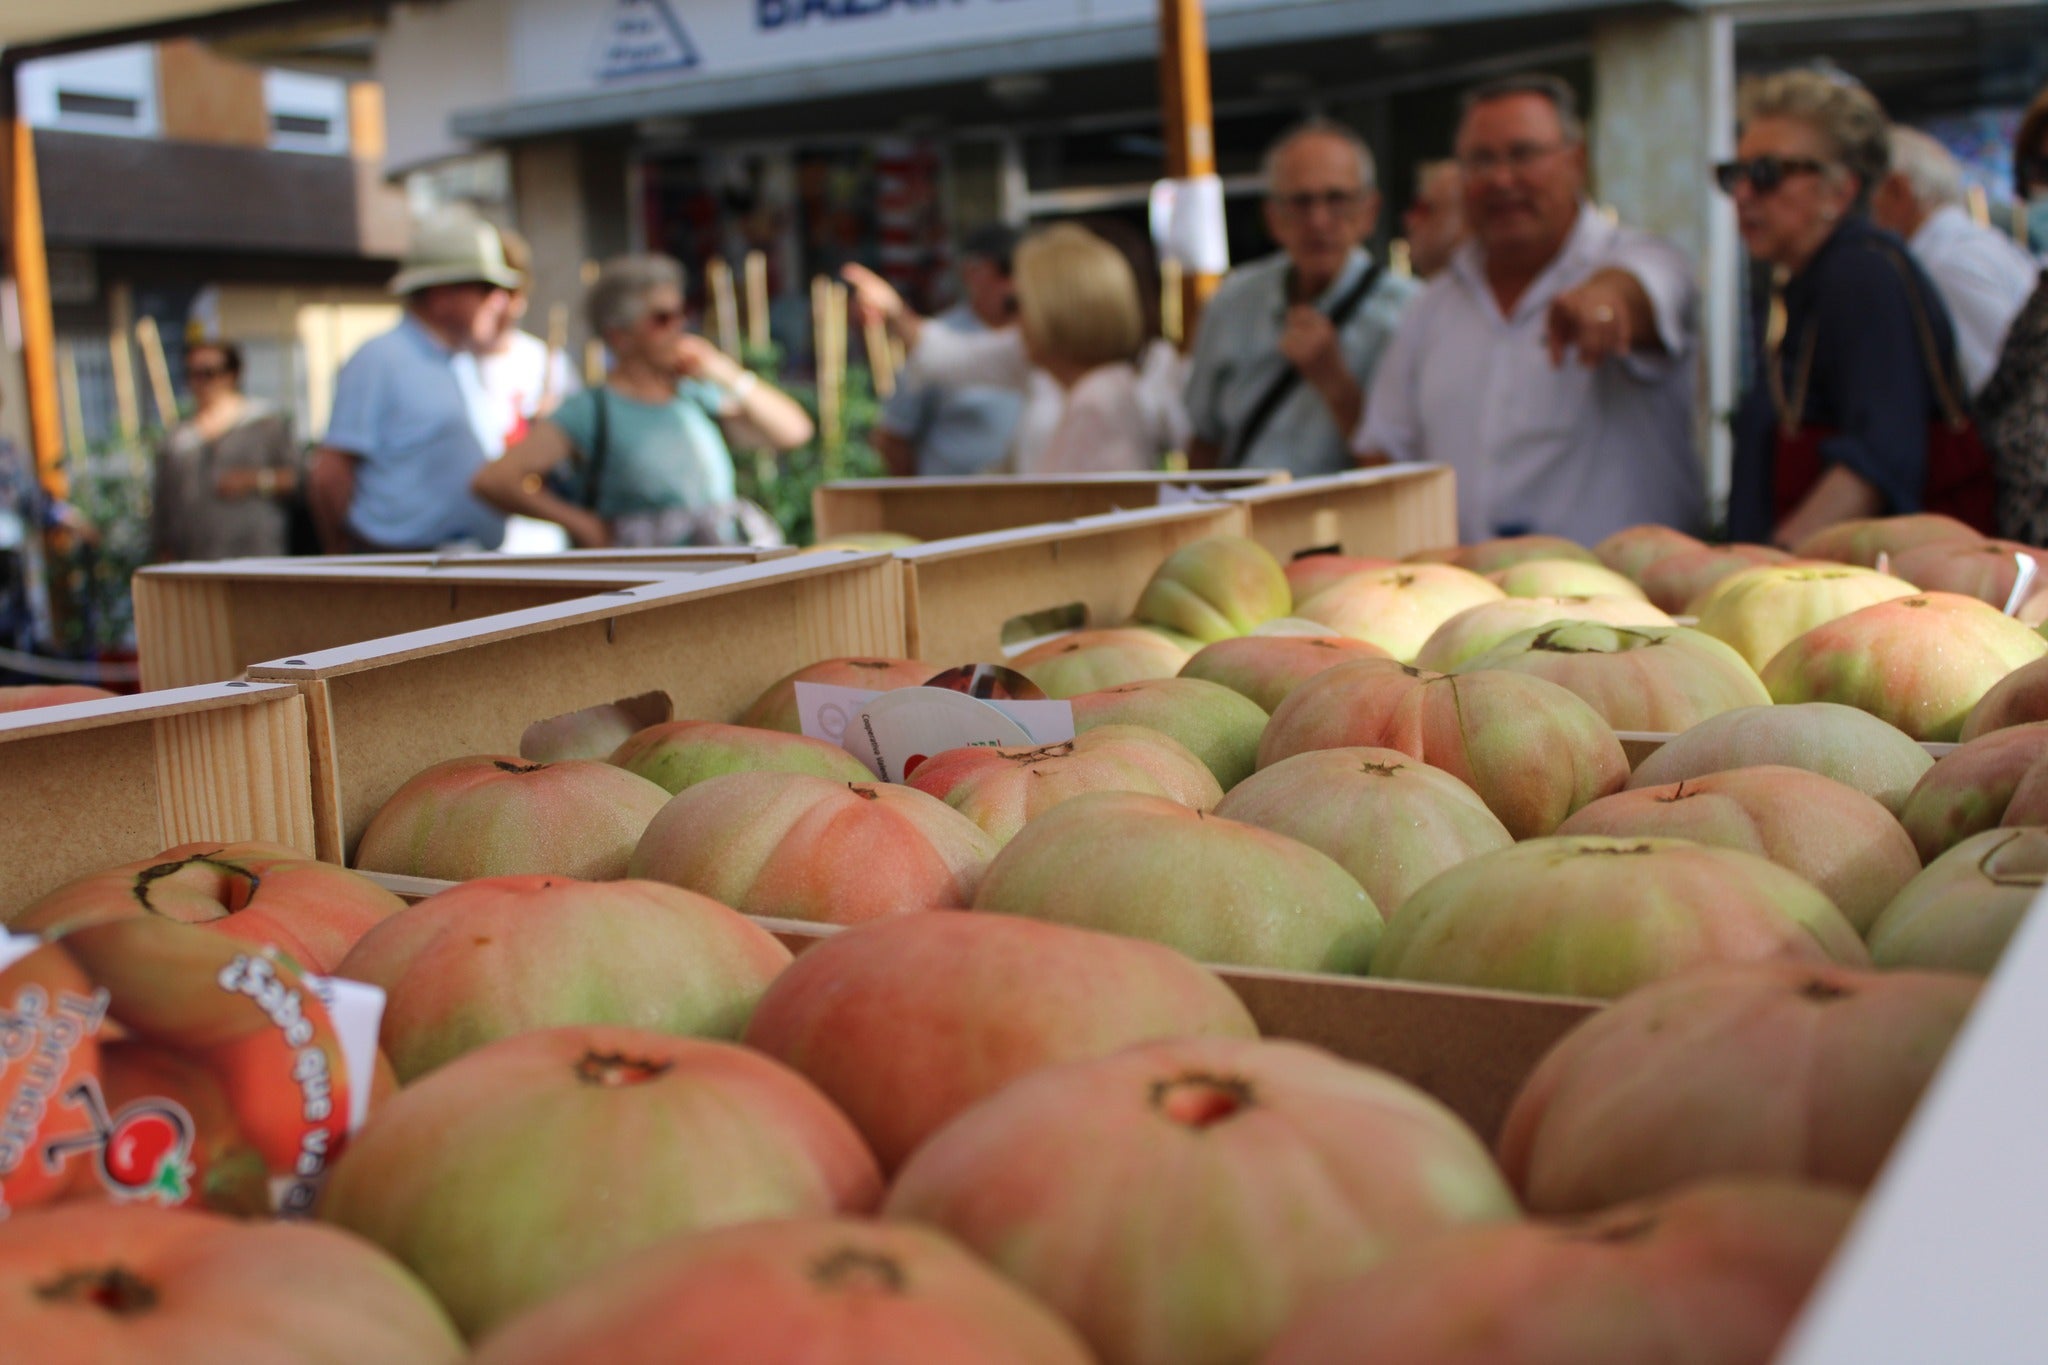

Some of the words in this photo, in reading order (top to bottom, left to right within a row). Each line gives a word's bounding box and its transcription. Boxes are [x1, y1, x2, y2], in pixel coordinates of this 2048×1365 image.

[0, 985, 111, 1176] Tomate
[292, 1047, 332, 1123] que
[297, 1127, 329, 1178] va
